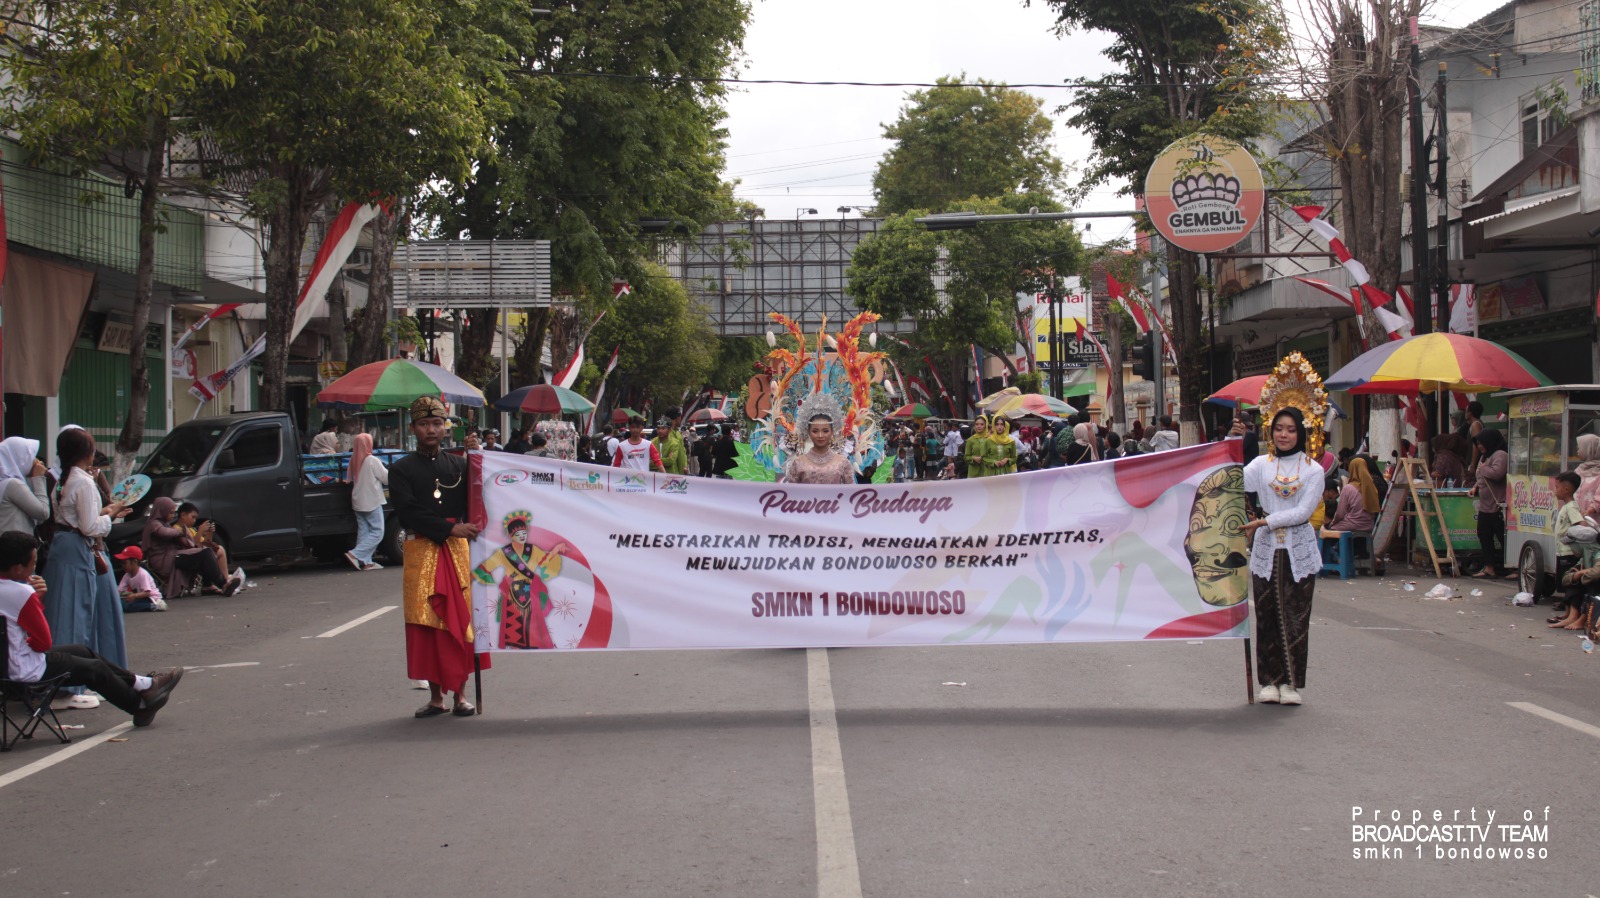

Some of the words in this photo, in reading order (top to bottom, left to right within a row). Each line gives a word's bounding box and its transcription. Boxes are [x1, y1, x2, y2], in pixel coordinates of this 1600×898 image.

[1169, 210, 1246, 228] GEMBUL
[758, 488, 844, 518] Pawai
[849, 488, 953, 524] Budaya
[608, 533, 761, 548] “MELESTARIKAN
[768, 534, 854, 550] TRADISI,
[861, 534, 989, 549] MENGUATKAN
[994, 529, 1105, 547] IDENTITAS,
[685, 556, 816, 571] MEWUJUDKAN
[822, 555, 937, 571] BONDOWOSO
[944, 552, 1028, 569] BERKAH”
[751, 591, 813, 618] SMKN
[819, 591, 830, 617] 1
[836, 590, 966, 616] BONDOWOSO
